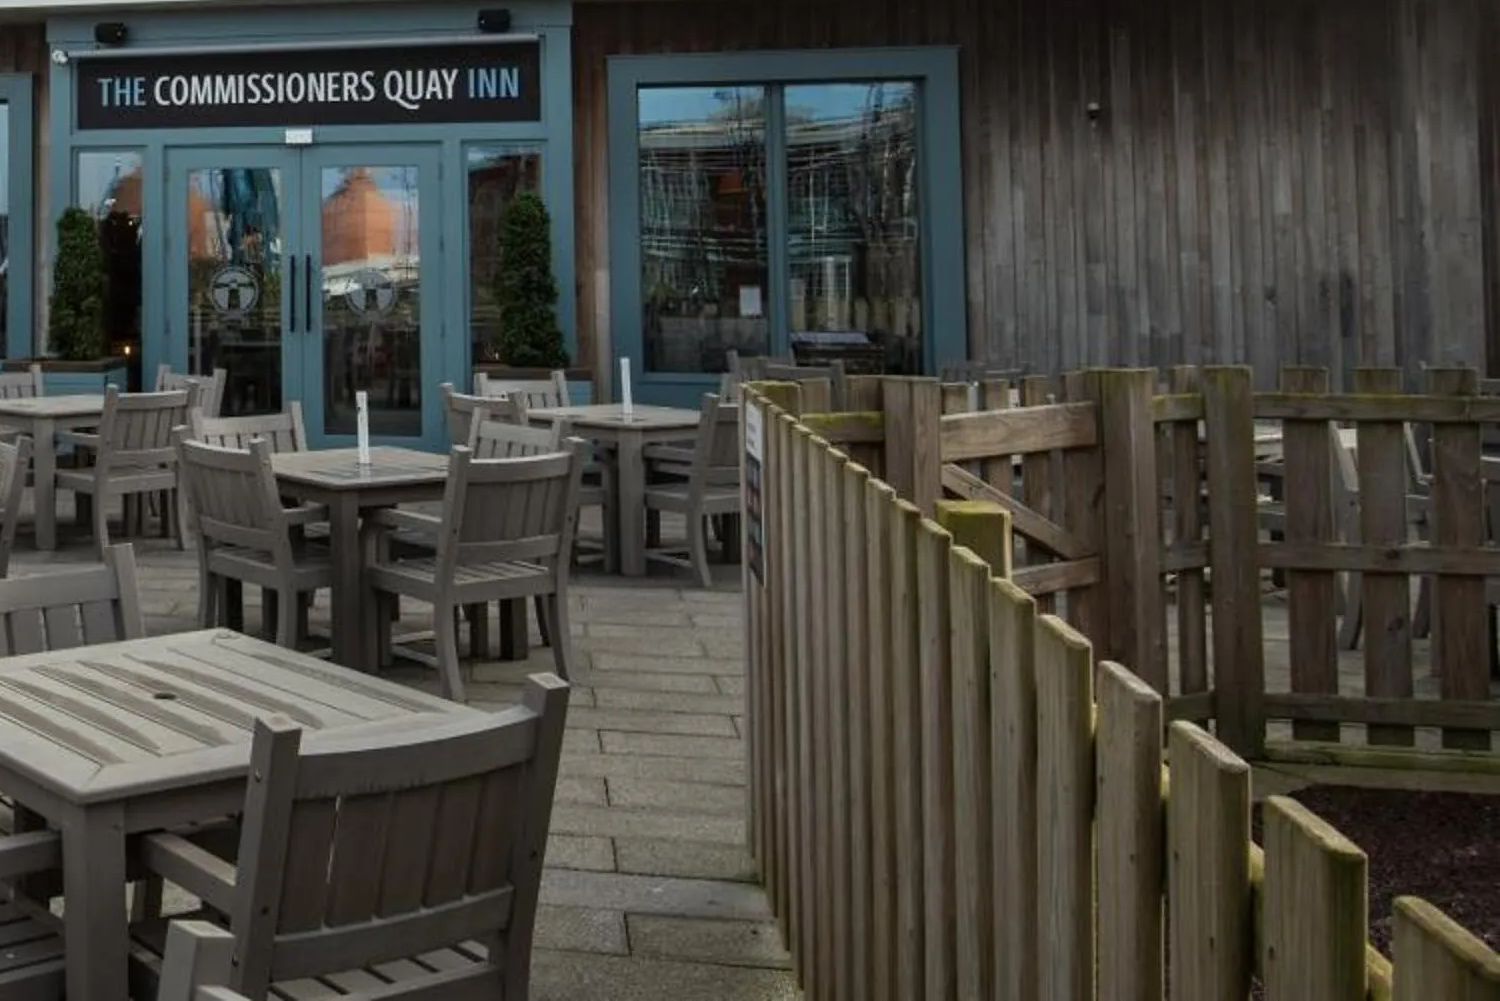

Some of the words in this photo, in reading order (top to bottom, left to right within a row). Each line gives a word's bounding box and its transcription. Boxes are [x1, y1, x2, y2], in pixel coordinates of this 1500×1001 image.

[96, 76, 147, 108] THE
[153, 70, 377, 107] COMMISSIONERS
[382, 67, 459, 111] QUAY
[467, 67, 520, 99] INN
